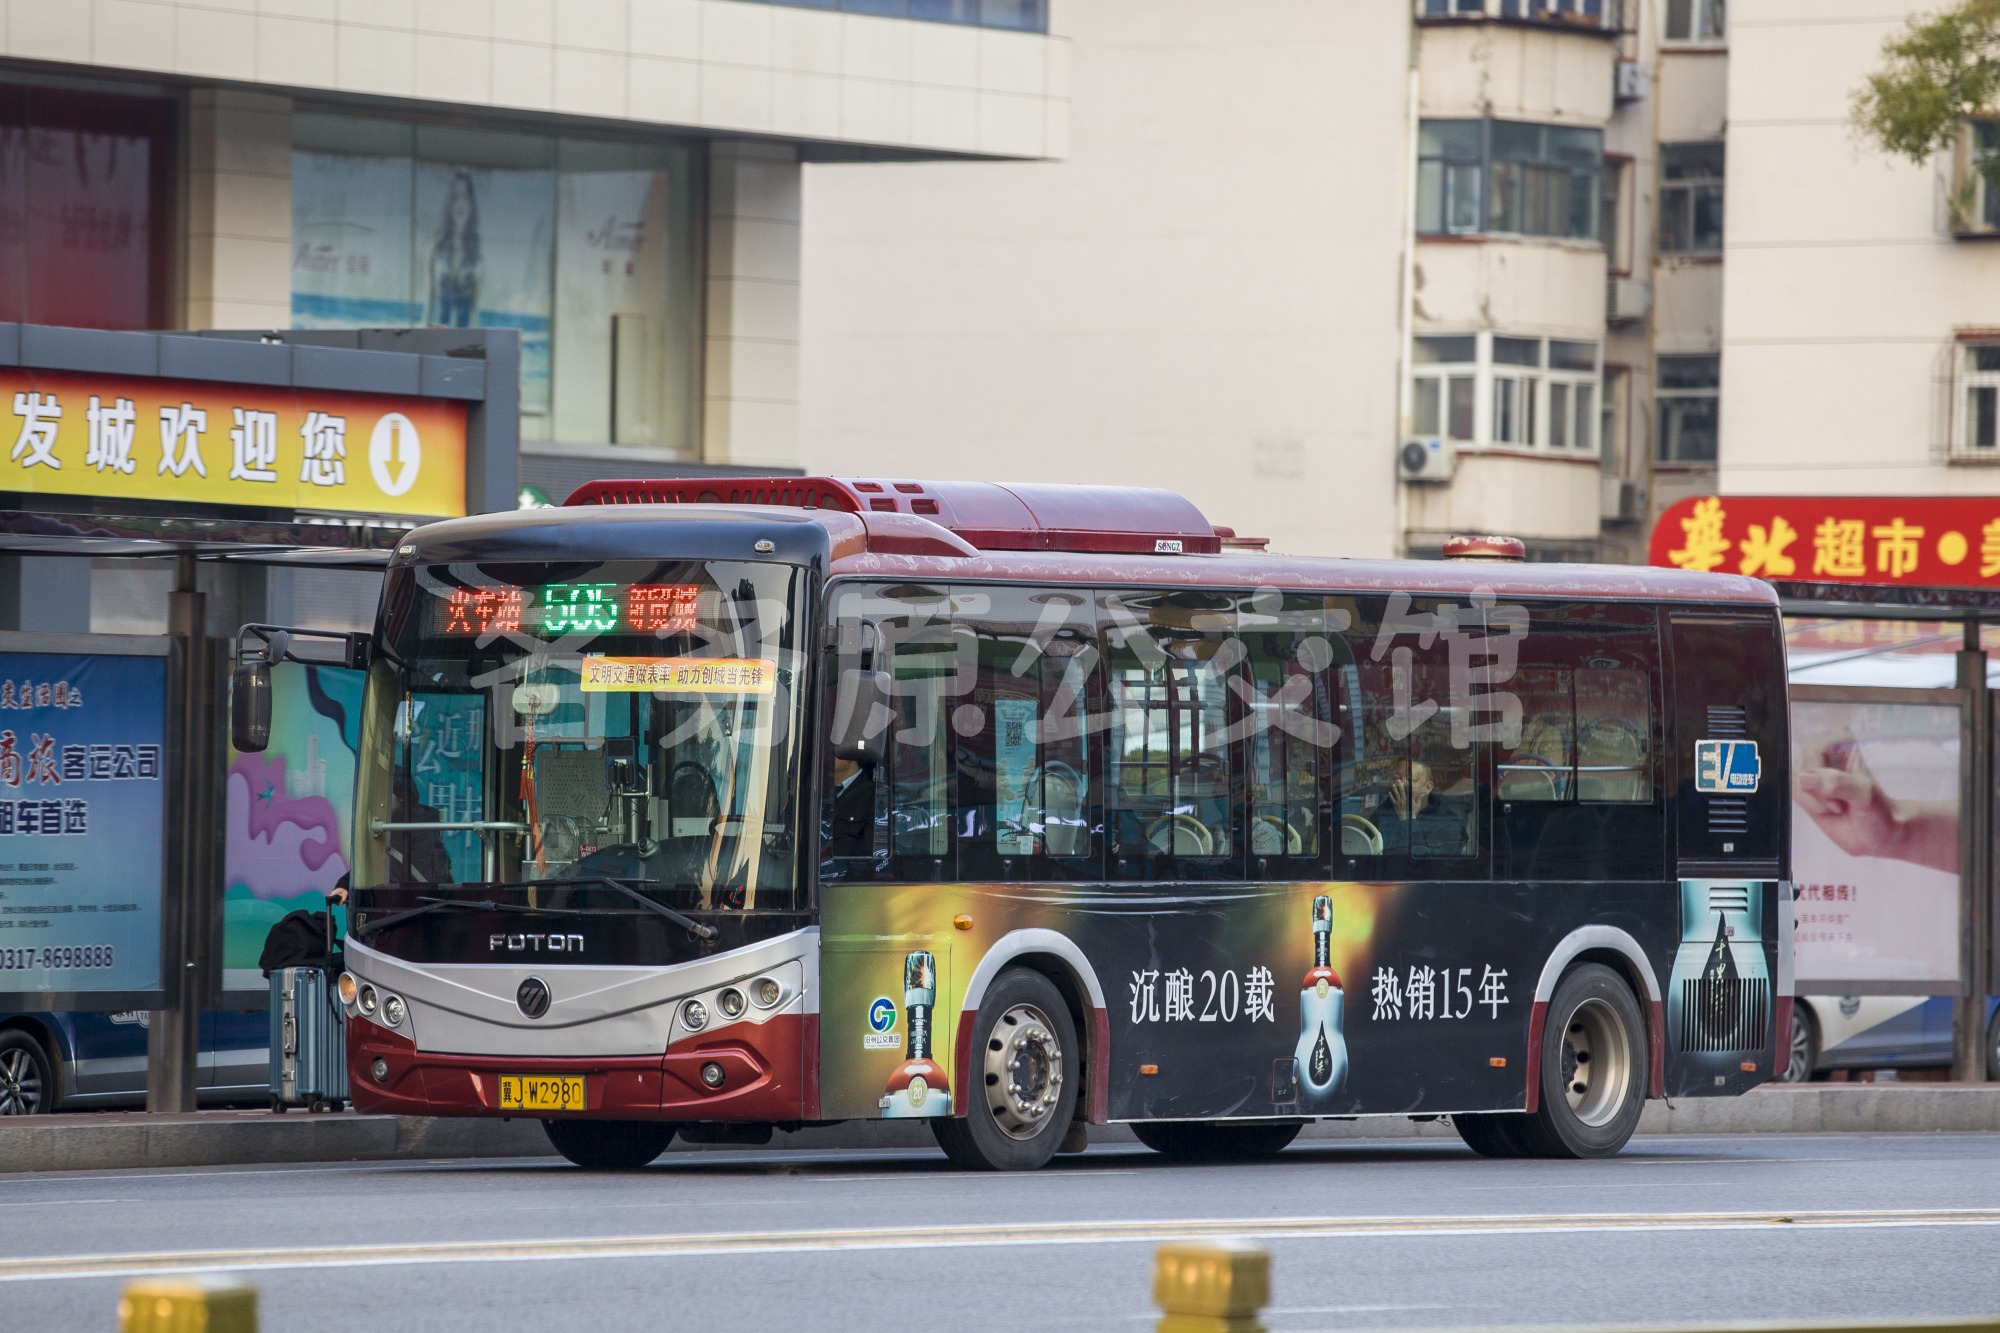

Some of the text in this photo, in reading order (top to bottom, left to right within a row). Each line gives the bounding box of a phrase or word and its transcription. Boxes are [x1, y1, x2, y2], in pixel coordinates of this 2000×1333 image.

[10, 391, 347, 487] 发城欢迎您
[1157, 541, 1181, 551] SONGZ
[589, 664, 765, 686] 文明交通做表率 助力创城当先锋
[489, 933, 584, 952] FOTON
[1129, 966, 1275, 1024] 沉酿20载
[1371, 963, 1510, 1021] 热销15年
